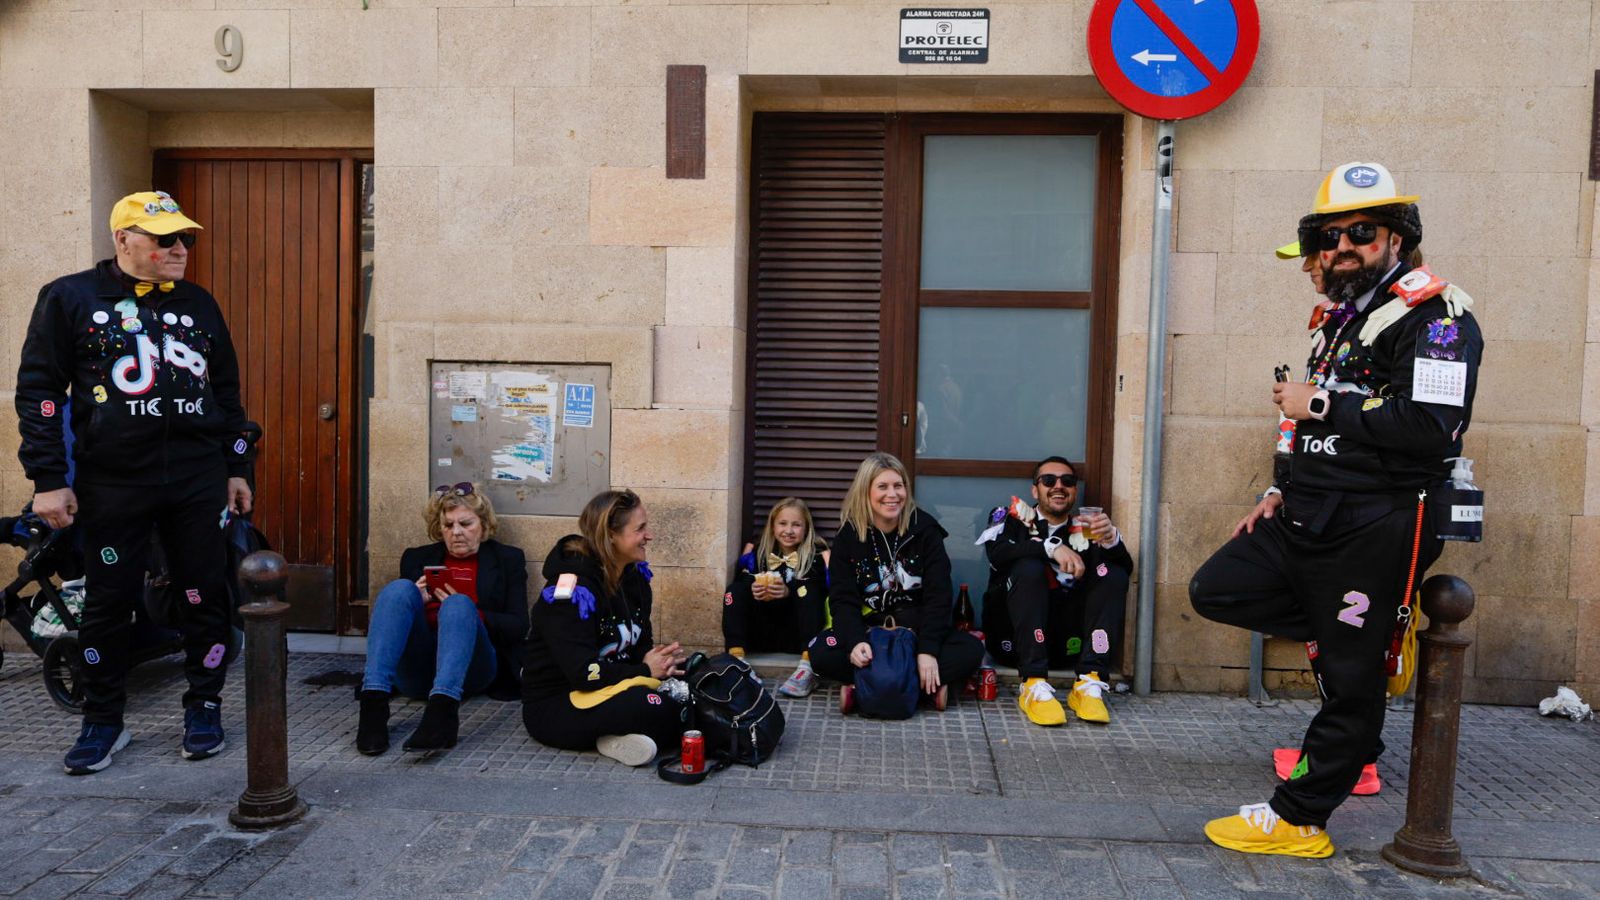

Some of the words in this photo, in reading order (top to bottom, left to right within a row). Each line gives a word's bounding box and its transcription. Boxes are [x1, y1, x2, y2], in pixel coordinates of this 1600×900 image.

[214, 24, 243, 73] 9
[905, 35, 983, 46] PROTELEC
[41, 400, 55, 417] 9
[234, 438, 247, 454] 0
[101, 547, 118, 564] 8
[186, 589, 201, 604] 5
[1337, 591, 1370, 628] 2
[1034, 629, 1044, 643] 6
[1092, 629, 1109, 654] 8
[84, 648, 100, 664] 0
[203, 643, 226, 669] 8
[587, 663, 600, 681] 2
